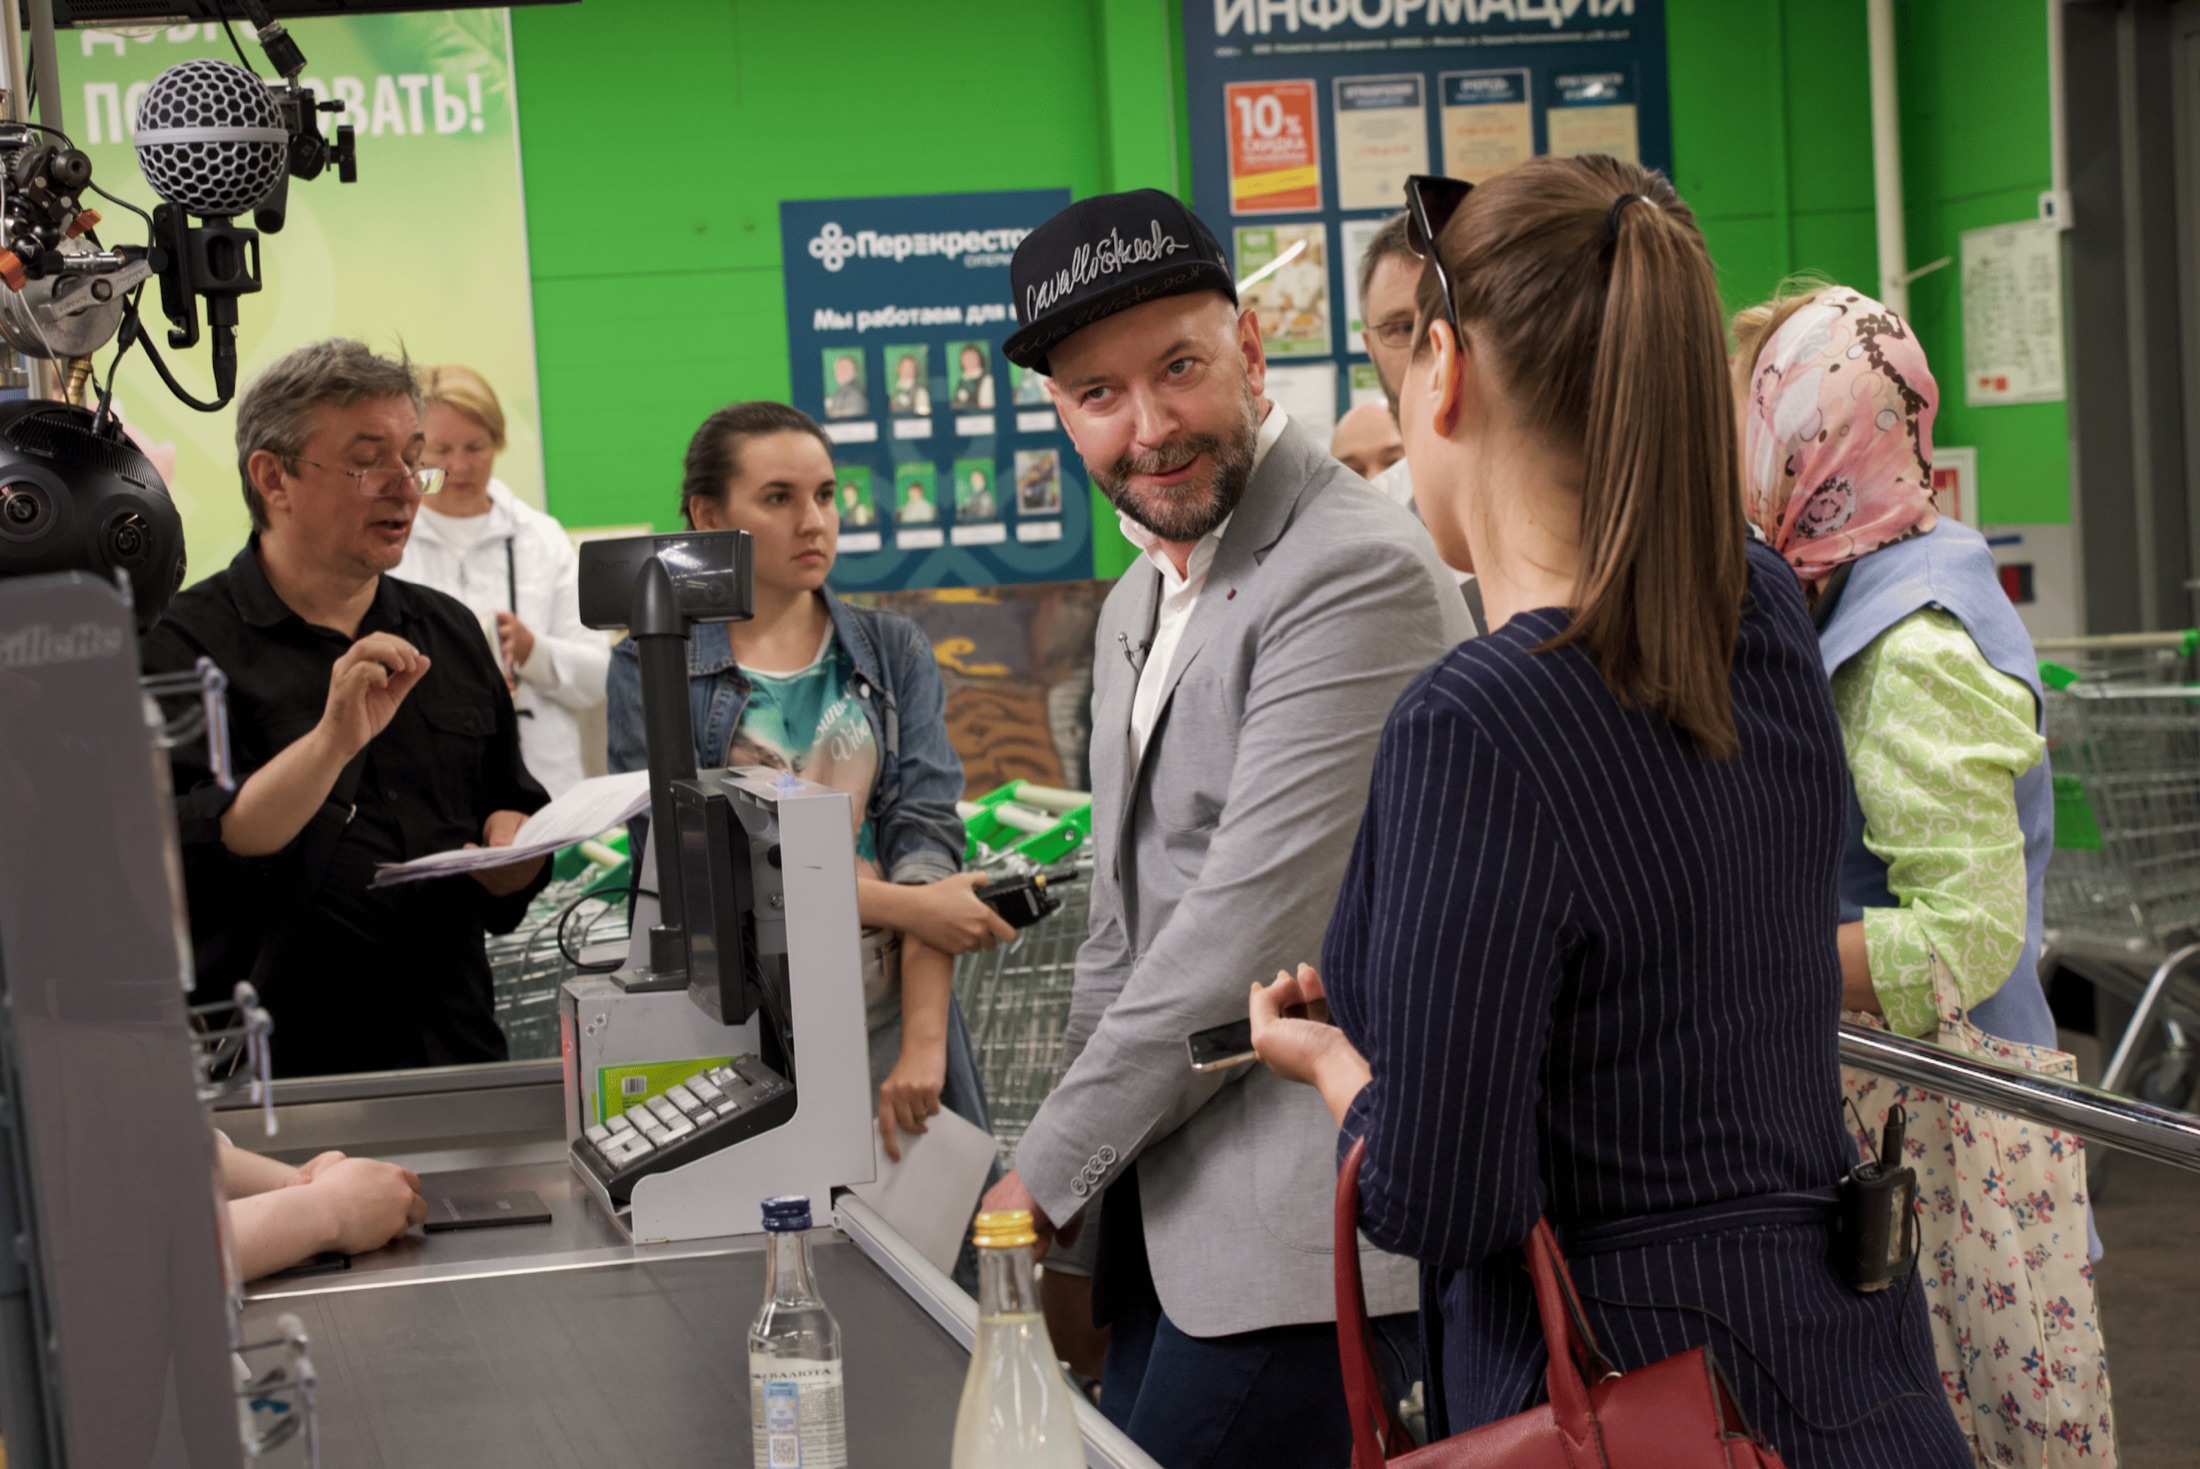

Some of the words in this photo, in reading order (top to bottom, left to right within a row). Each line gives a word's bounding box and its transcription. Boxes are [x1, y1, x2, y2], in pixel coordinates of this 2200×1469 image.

[856, 228, 1035, 263] Перекресто
[813, 308, 853, 331] Мы
[856, 305, 963, 334] работаем
